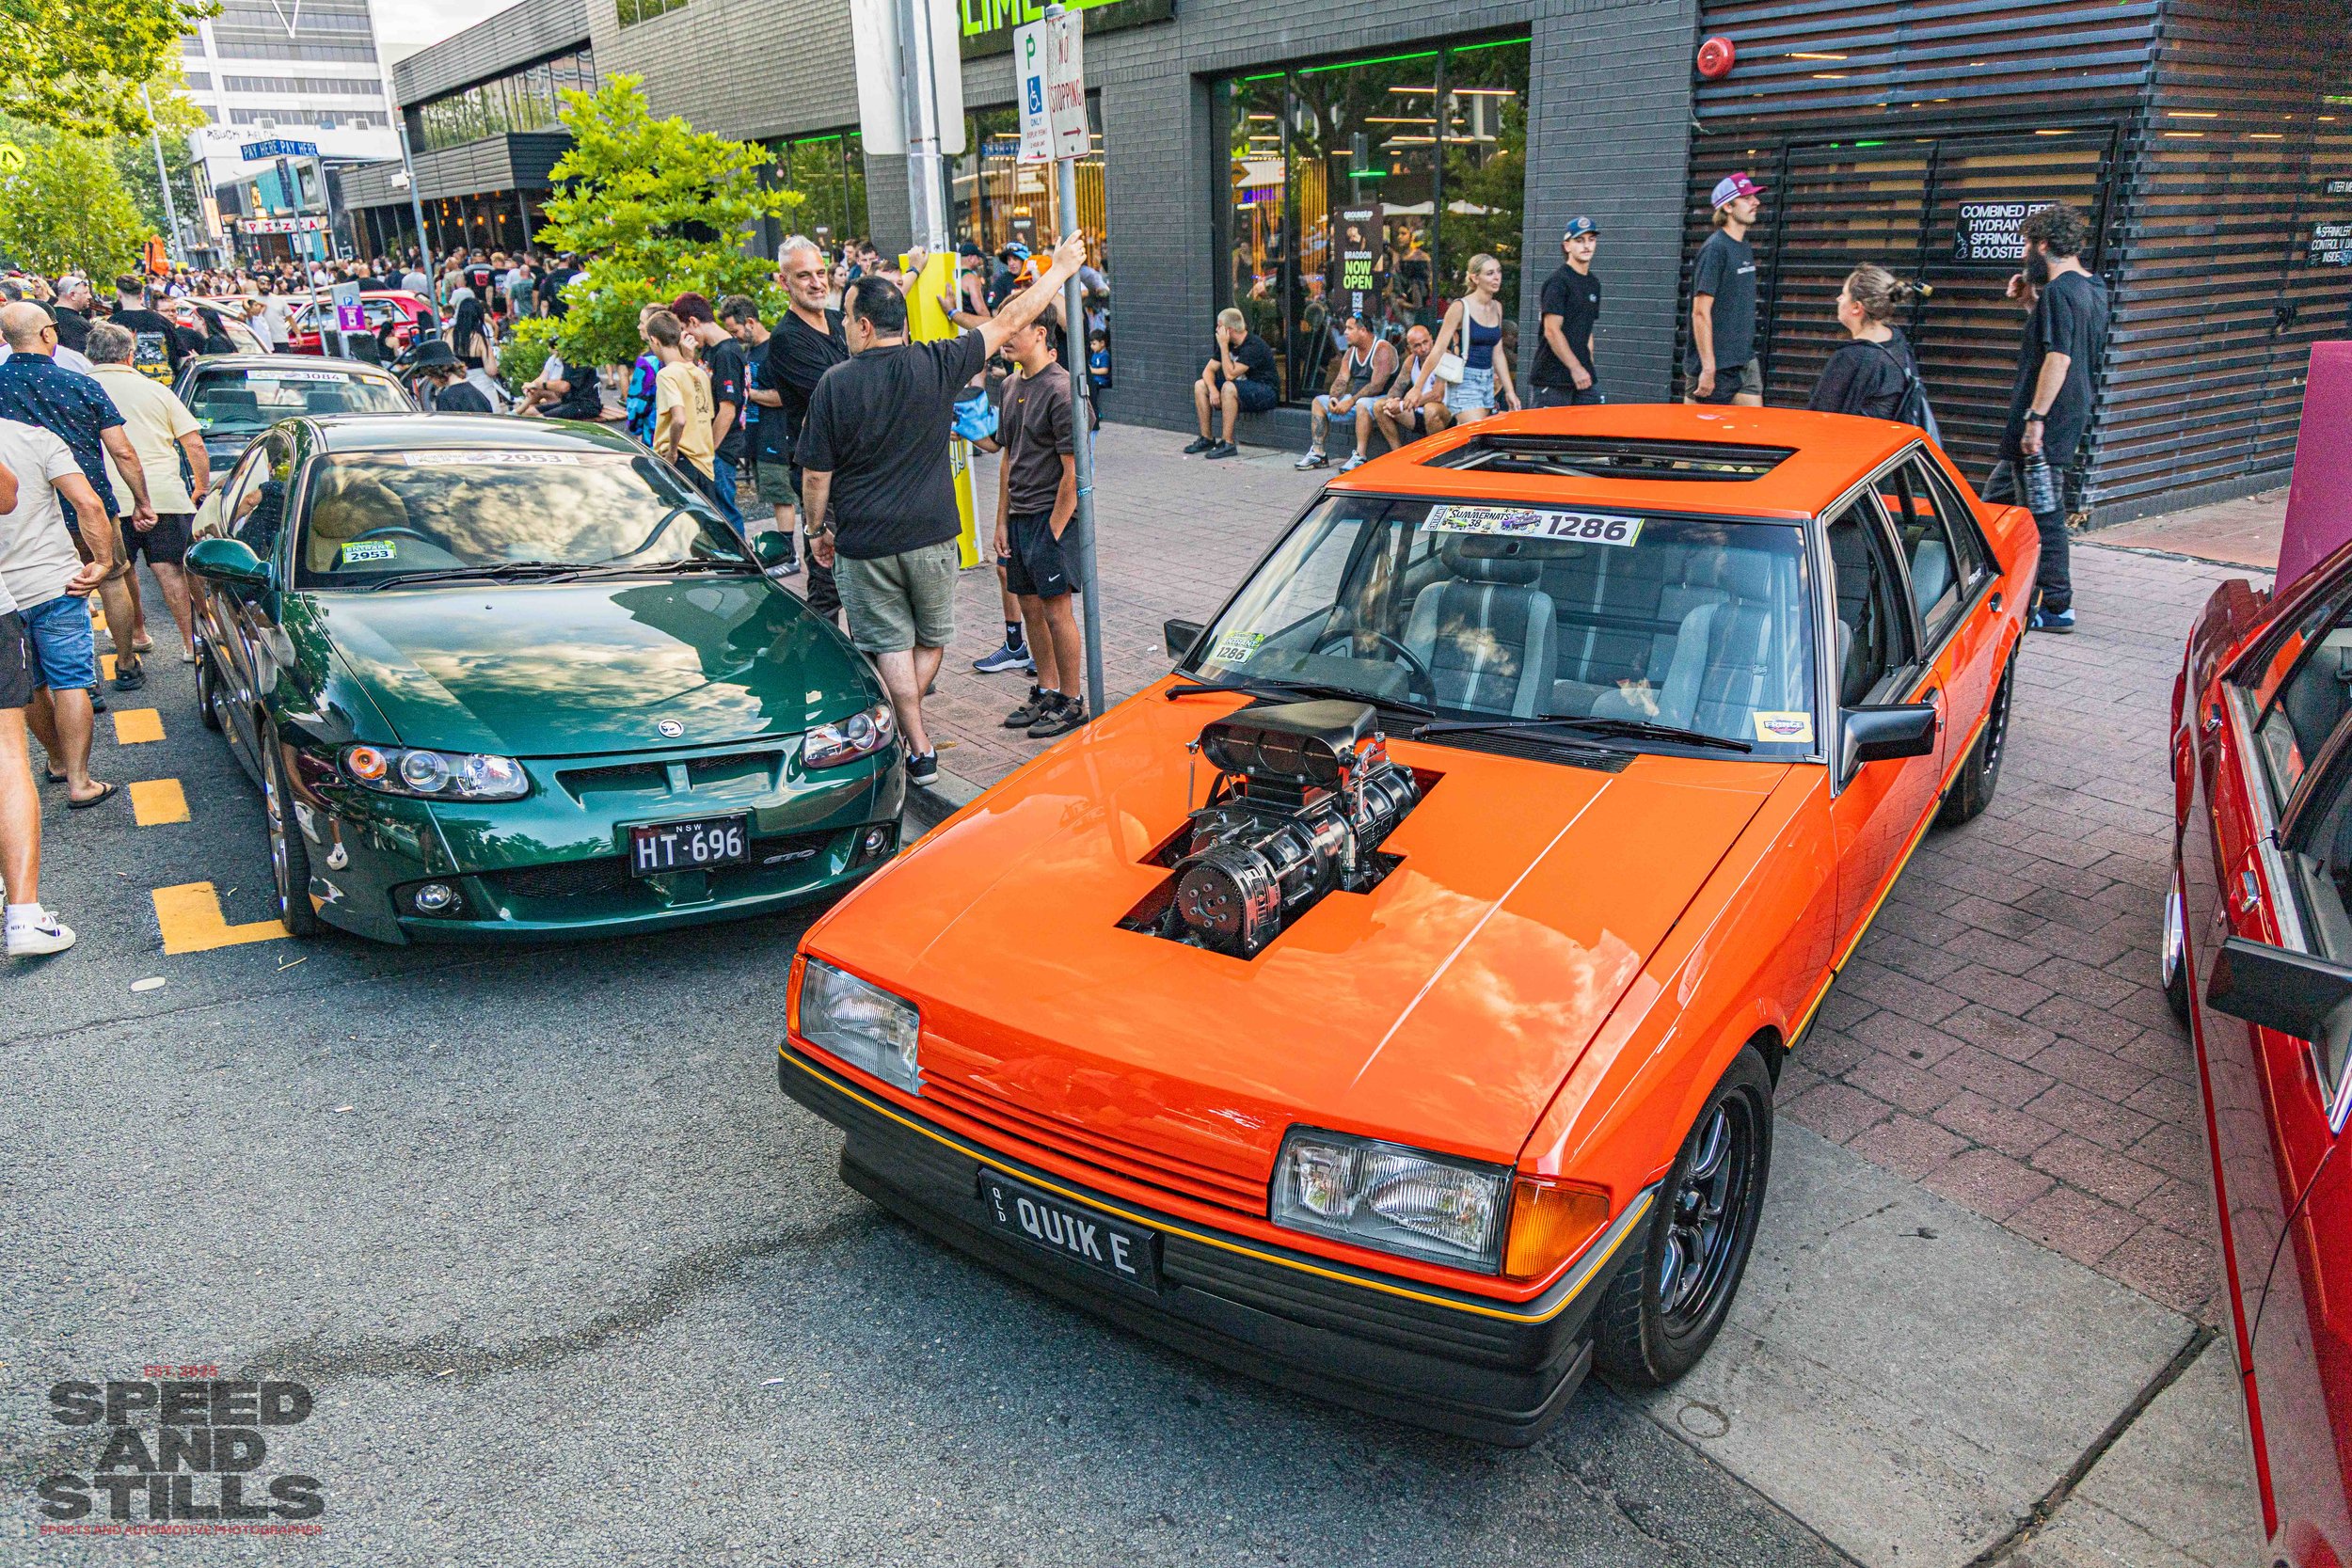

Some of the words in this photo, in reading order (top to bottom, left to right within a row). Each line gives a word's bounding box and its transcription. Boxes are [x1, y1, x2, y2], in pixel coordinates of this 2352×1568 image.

[1025, 38, 1036, 71] P
[1058, 36, 1070, 65] NO
[1050, 78, 1082, 113] STOPPING
[243, 145, 257, 159] PAY
[259, 142, 278, 156] HERE
[280, 141, 296, 154] PAY
[298, 143, 318, 156] HERE
[1962, 205, 2025, 218] COMBINED
[2027, 204, 2056, 216] FIR
[248, 220, 318, 232] PIZA
[1968, 219, 2026, 231] HYDRAN
[1970, 233, 2026, 245] SPRINKLE
[2312, 240, 2338, 250] CONTROL
[1972, 246, 2026, 259] BOOSTE
[1345, 261, 1371, 275] NOW
[1343, 275, 1373, 290] OPEN
[500, 453, 562, 463] 2953
[1450, 509, 1511, 520] SUMMERNATS
[1548, 515, 1627, 541] 1286
[351, 550, 389, 561] 2953
[1216, 647, 1247, 660] 1286
[676, 823, 702, 832] NSW
[993, 1187, 1007, 1222] QLD
[1017, 1197, 1103, 1261] QUIK
[1109, 1232, 1136, 1275] E
